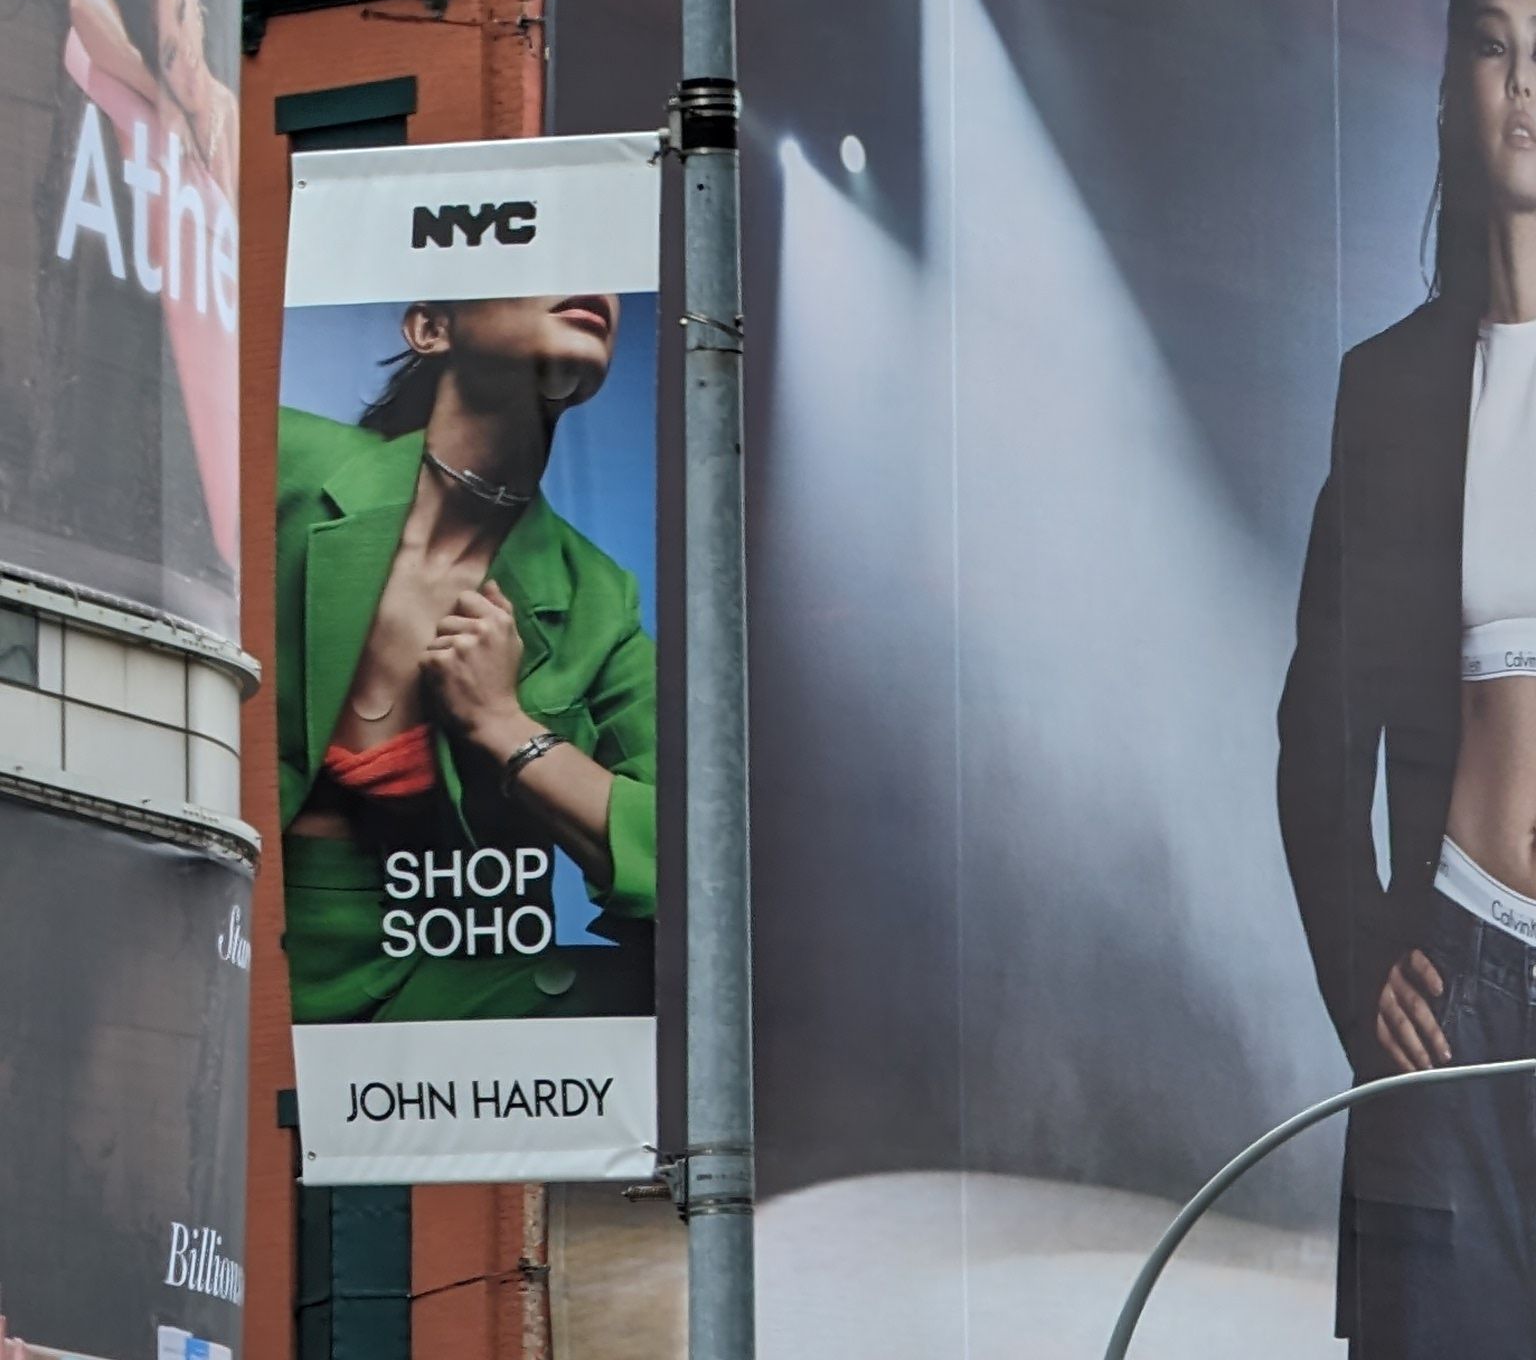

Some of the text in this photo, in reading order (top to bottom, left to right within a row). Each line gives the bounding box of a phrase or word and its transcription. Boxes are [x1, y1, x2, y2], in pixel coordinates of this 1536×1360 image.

[411, 201, 537, 248] NYC
[385, 847, 549, 900] SHOP
[381, 905, 552, 958] SOHO
[347, 1077, 614, 1123] JOHN HARDY
